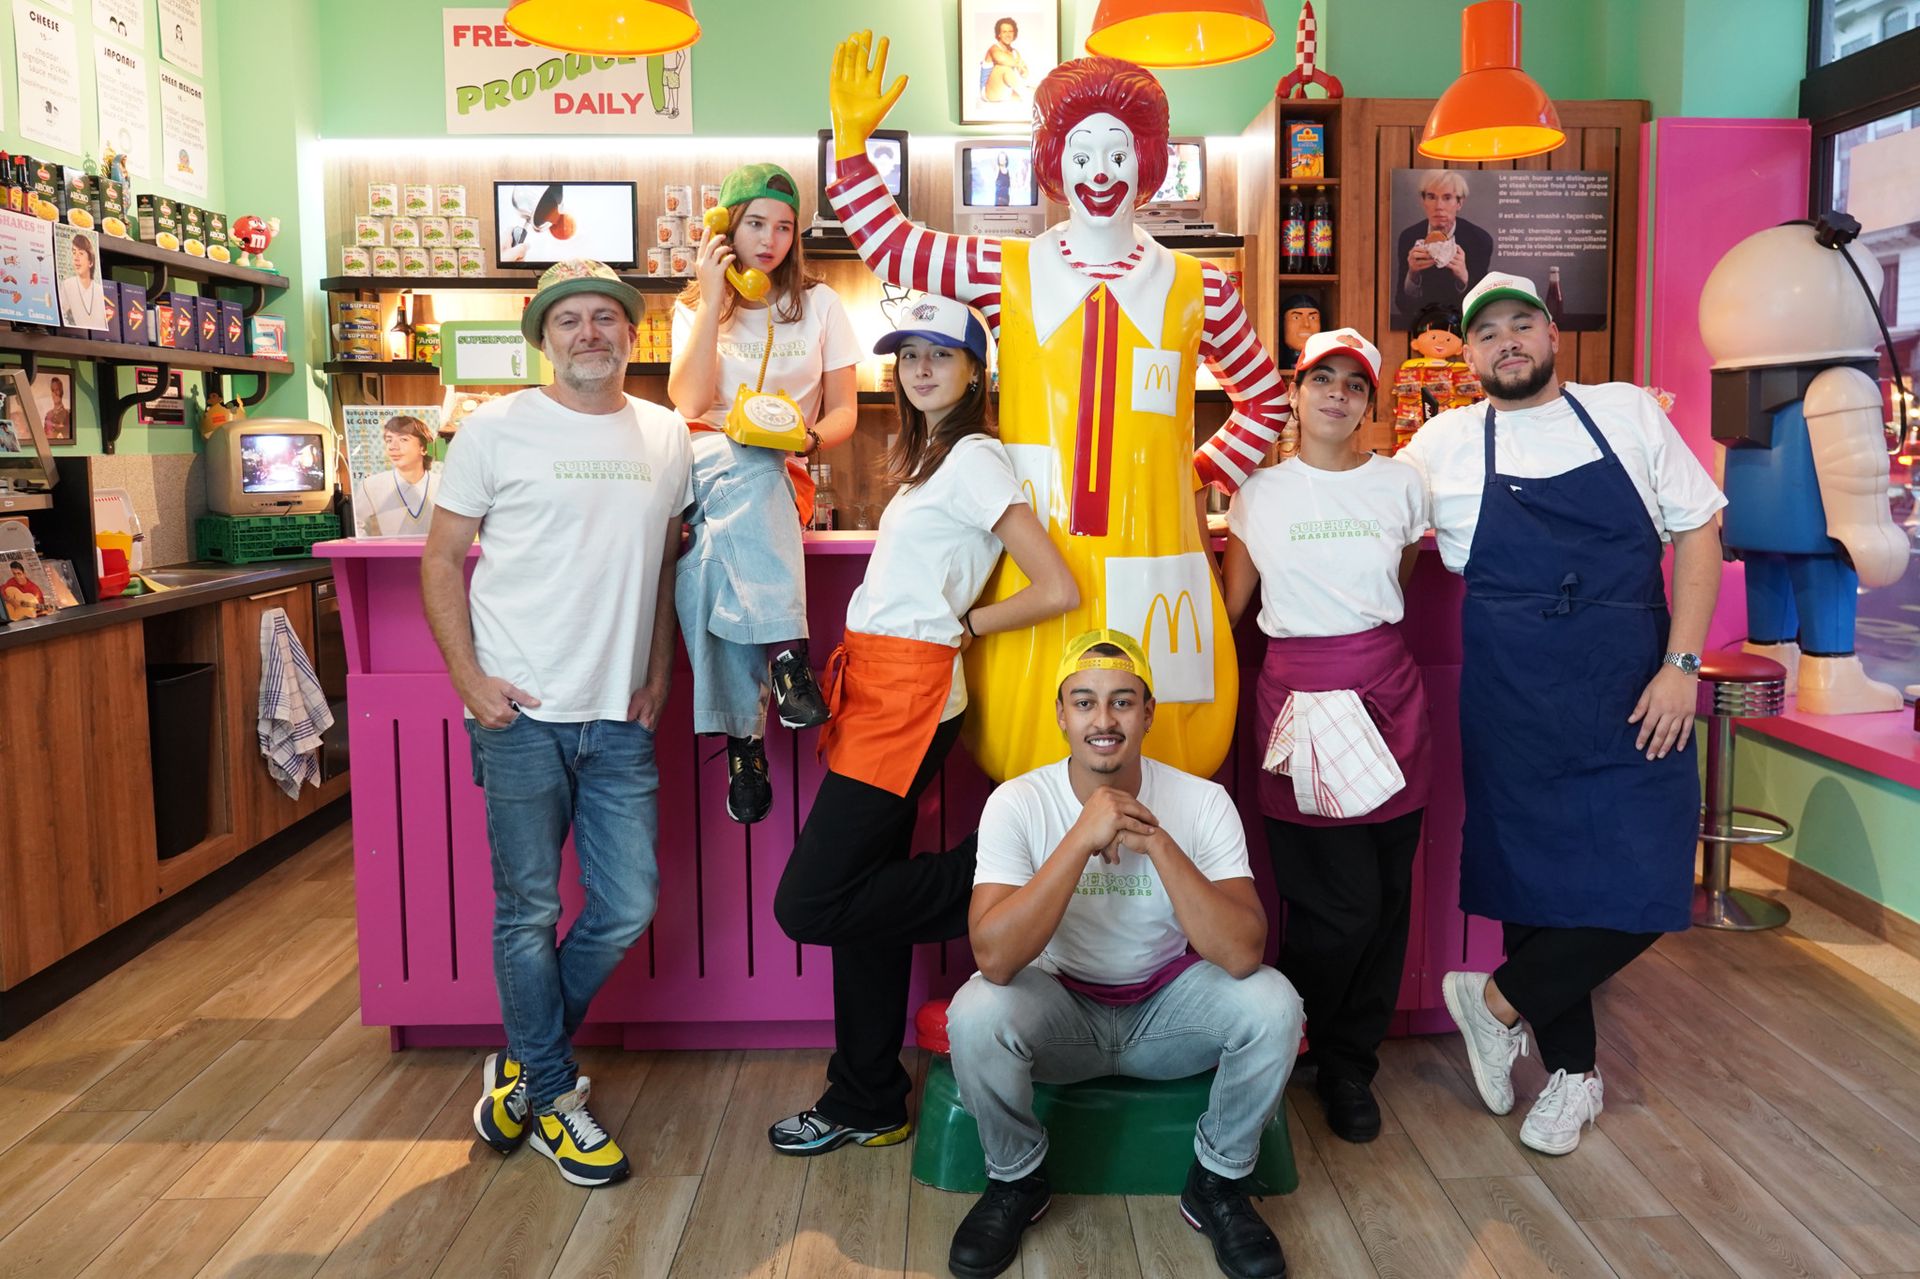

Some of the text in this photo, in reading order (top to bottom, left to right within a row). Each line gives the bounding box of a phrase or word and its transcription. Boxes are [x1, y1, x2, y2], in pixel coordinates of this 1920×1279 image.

[29, 11, 60, 32] CHEESE
[453, 25, 541, 47] FRE
[104, 47, 136, 69] JAPONAIS
[161, 73, 202, 100] GREEN MEXICAN
[554, 93, 645, 115] DAILY
[457, 335, 525, 344] SUPERFOOD
[553, 459, 652, 473] SUPERFOOD
[554, 472, 652, 483] SMASHBURGERS
[1289, 519, 1382, 533] SUPERFOOD
[1290, 529, 1381, 542] SMASHBURGERS
[1078, 872, 1152, 888] PERFOOD
